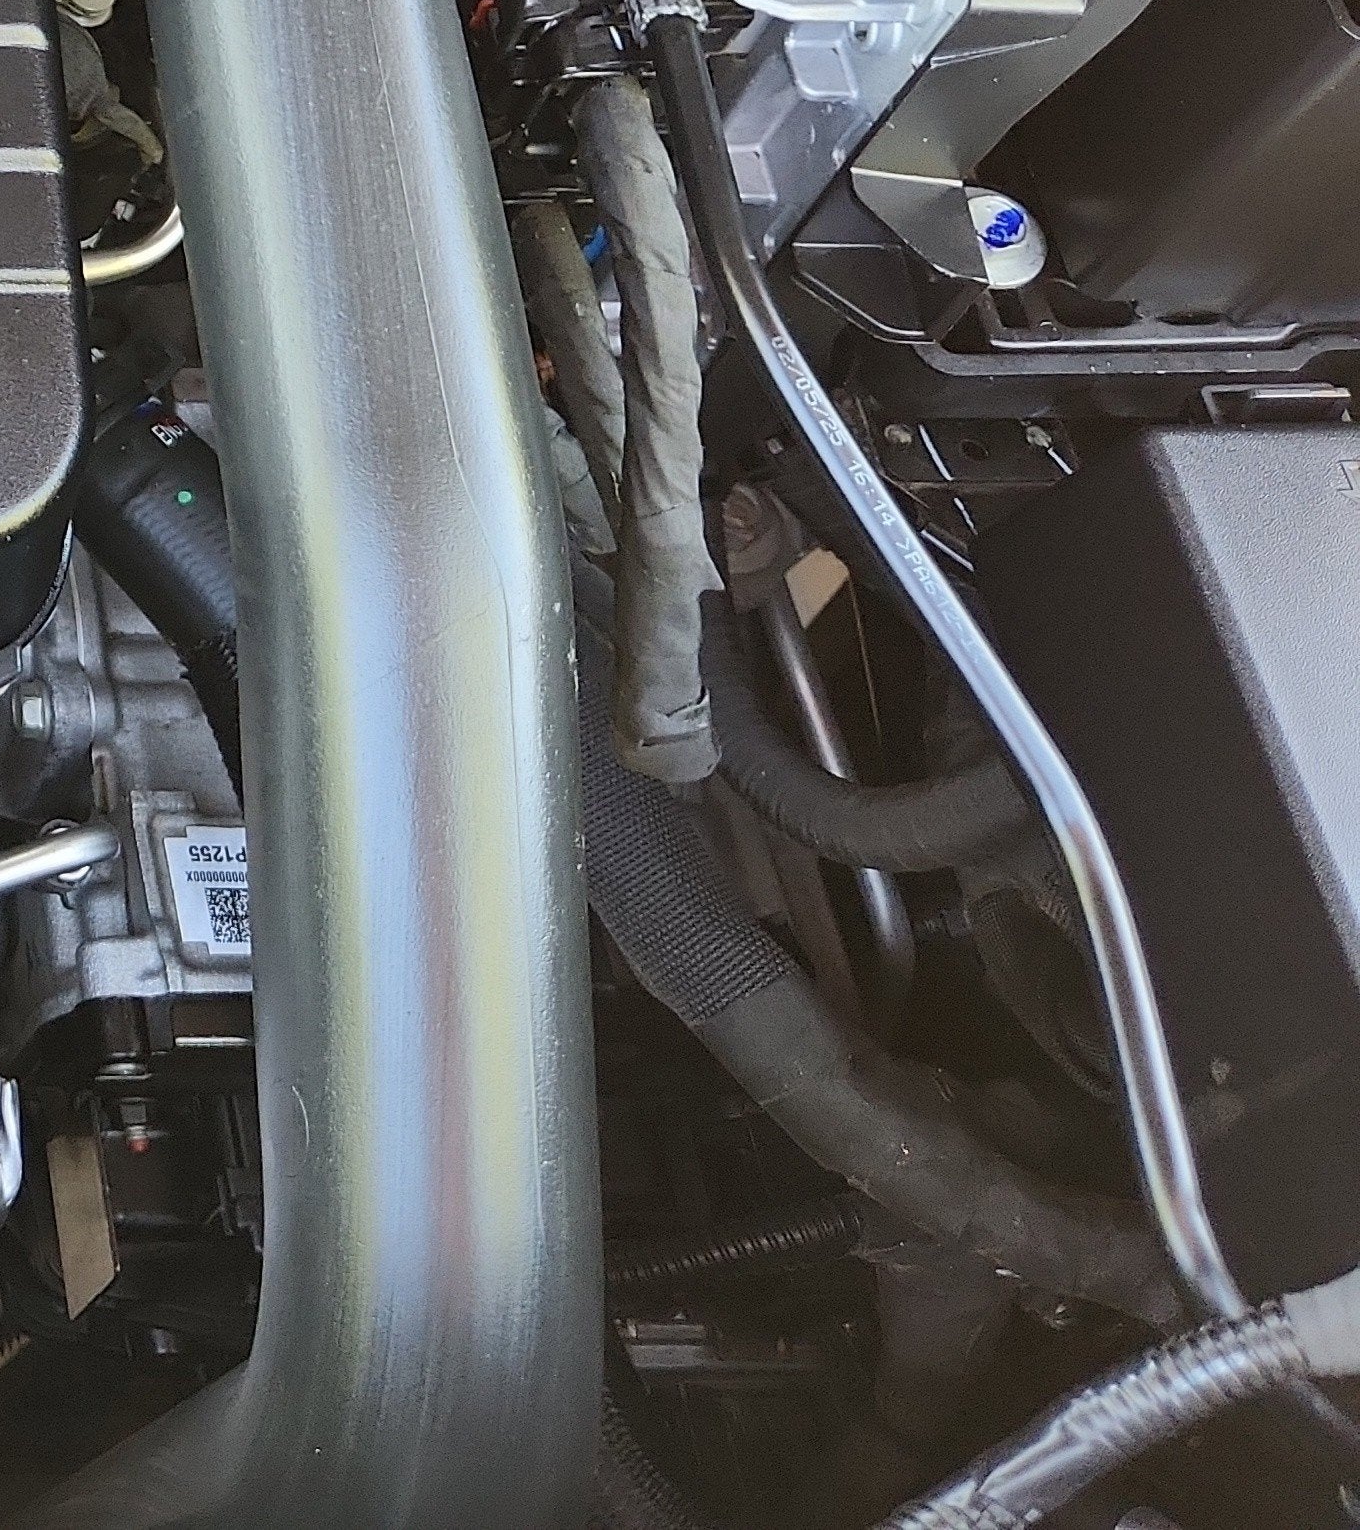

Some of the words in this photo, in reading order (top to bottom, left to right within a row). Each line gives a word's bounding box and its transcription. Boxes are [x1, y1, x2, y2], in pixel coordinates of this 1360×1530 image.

[771, 336, 852, 447] 02/05/25
[848, 459, 897, 526] 16:14
[188, 845, 247, 863] P1255
